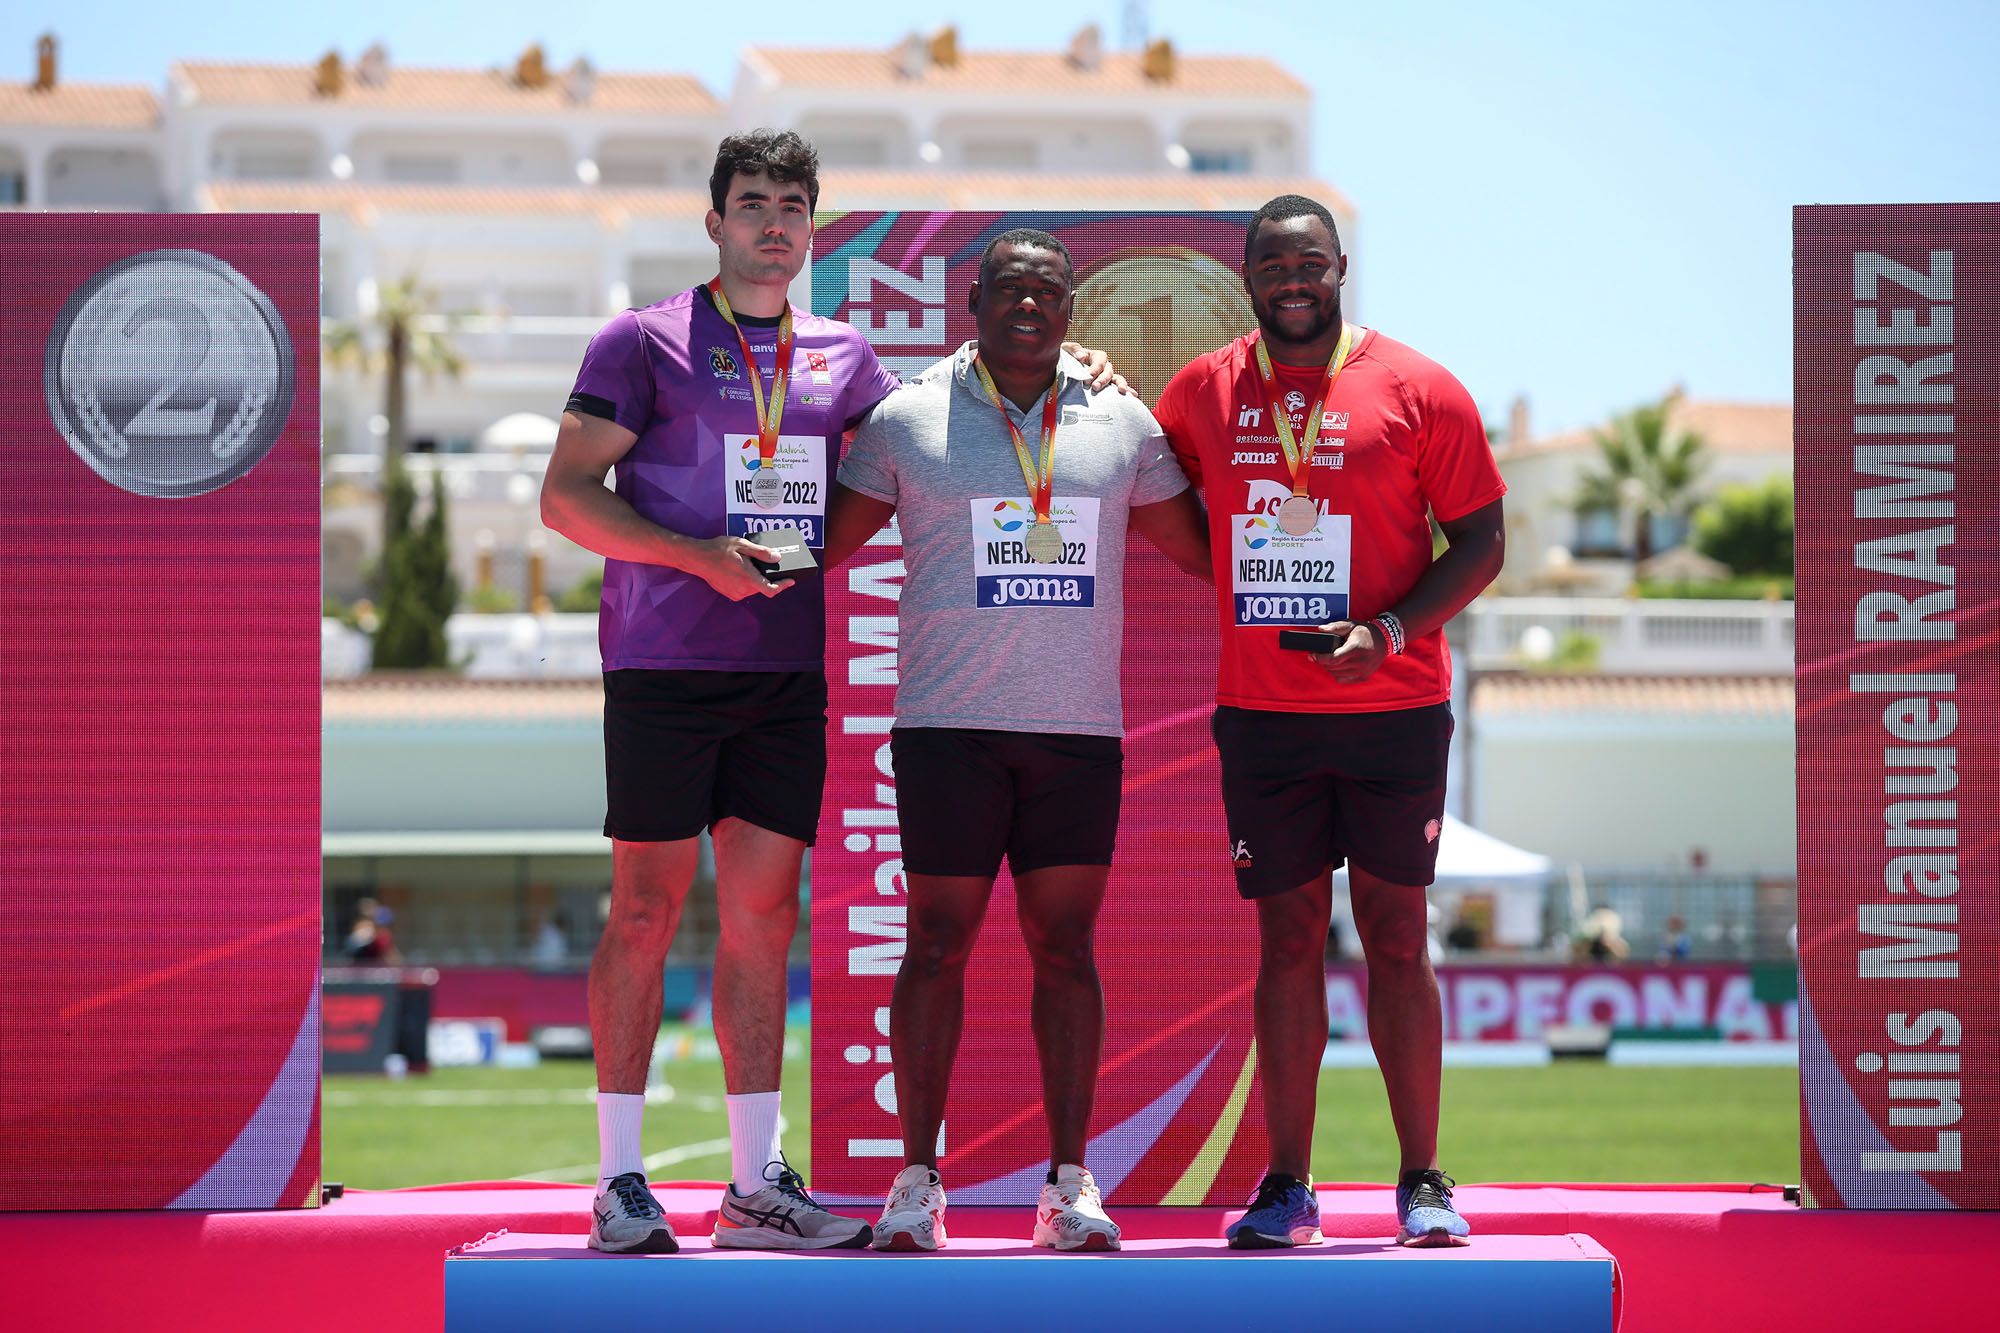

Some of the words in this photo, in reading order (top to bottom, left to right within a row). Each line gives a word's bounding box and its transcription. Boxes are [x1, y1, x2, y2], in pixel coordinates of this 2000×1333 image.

[122, 298, 217, 437] 2
[783, 482, 818, 505] 2022
[1854, 250, 1955, 640] RAMIREZ
[1239, 559, 1287, 582] NERJA
[1291, 560, 1335, 582] 2022
[1850, 673, 1960, 978] Manuel
[1856, 1008, 1963, 1171] Luis
